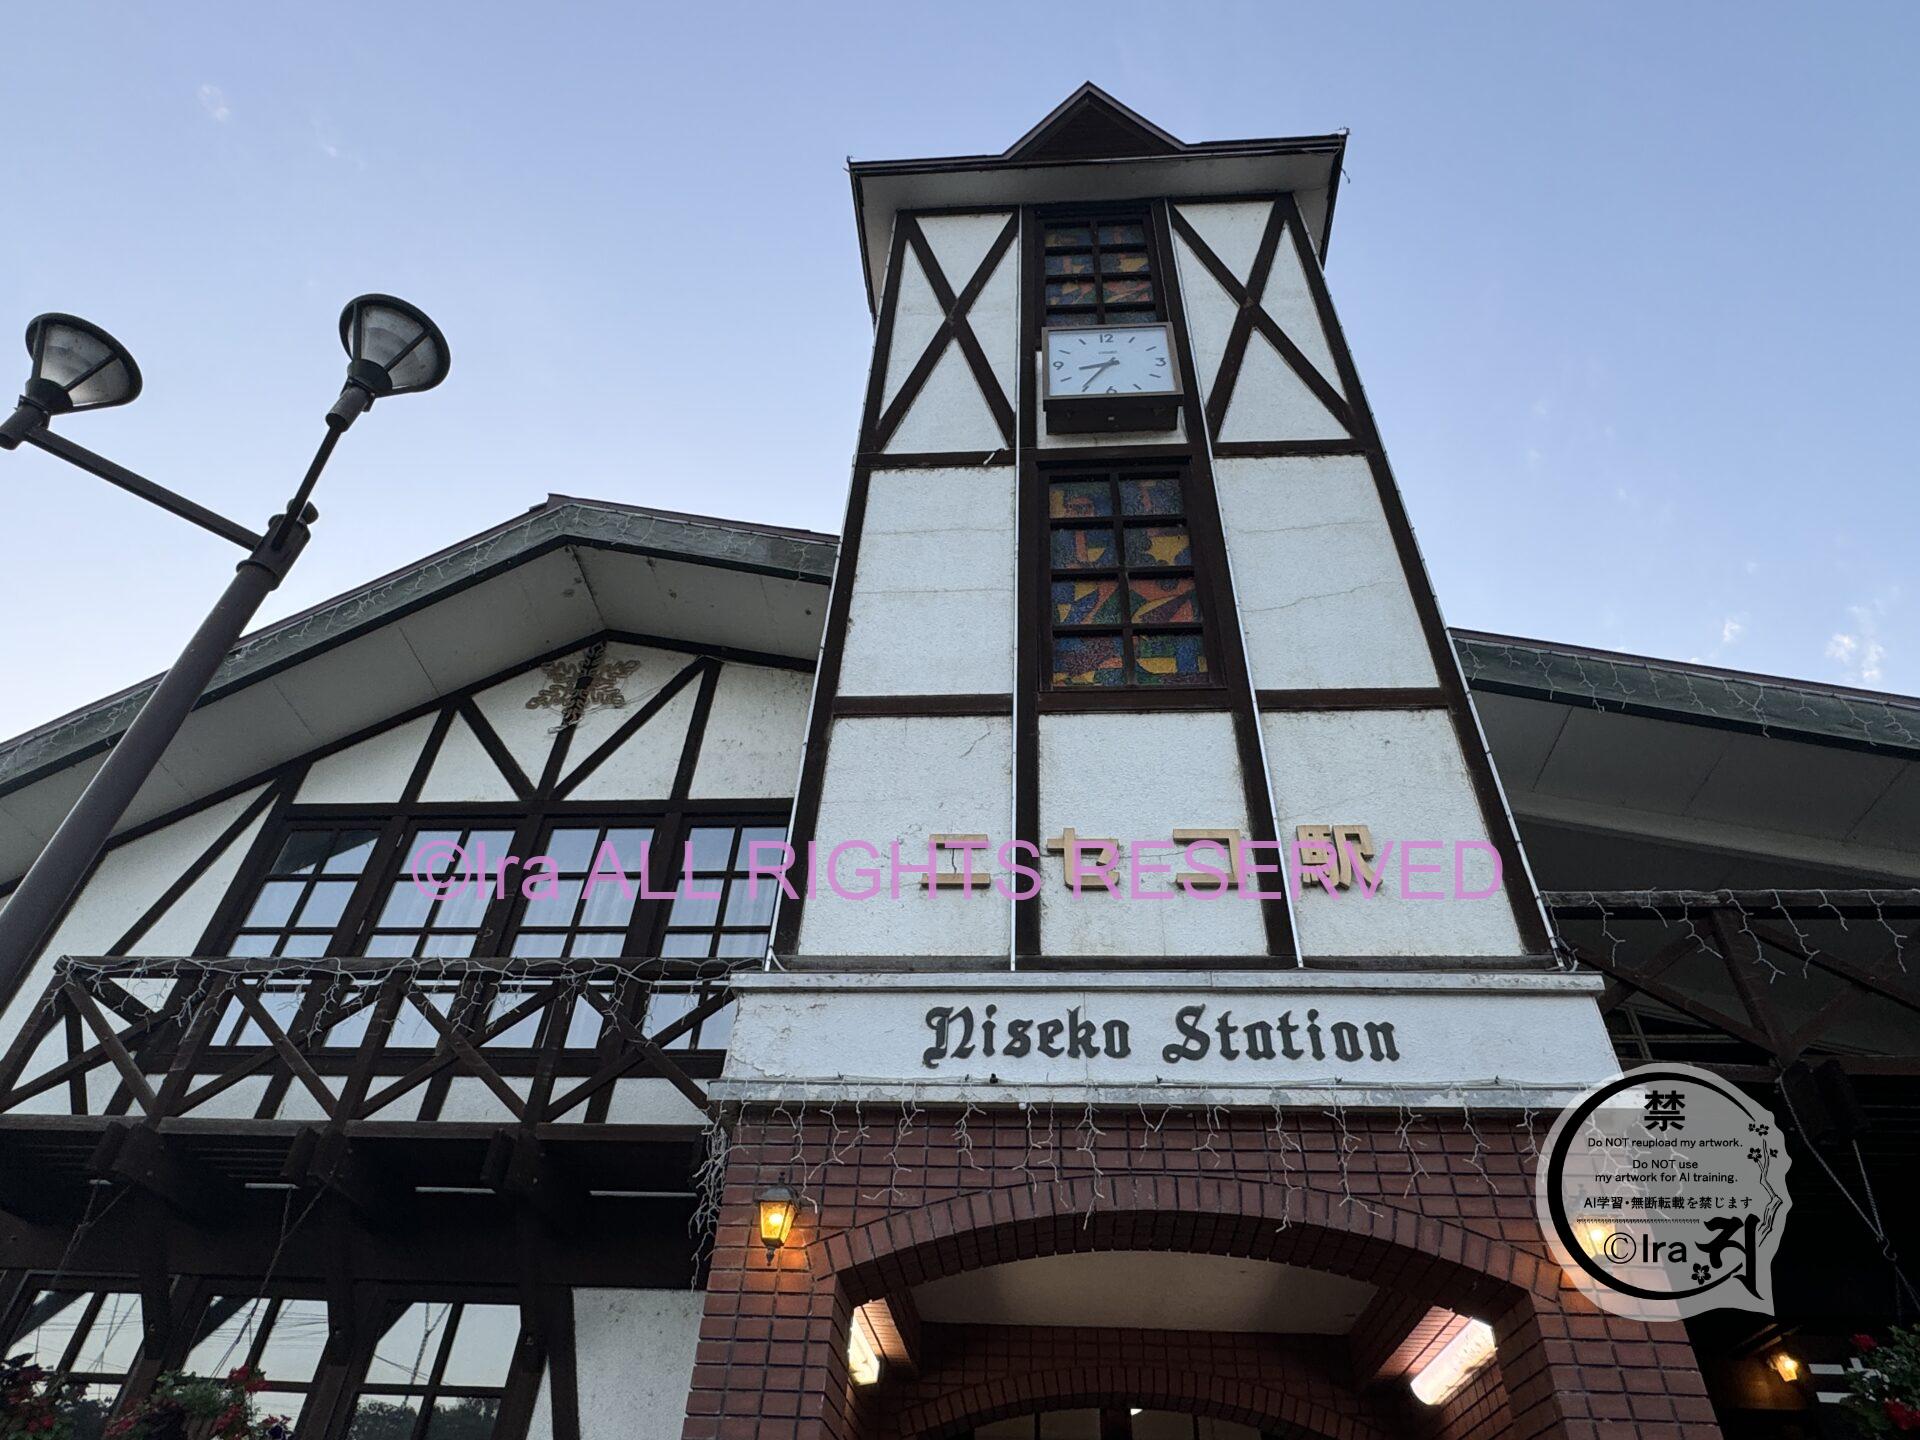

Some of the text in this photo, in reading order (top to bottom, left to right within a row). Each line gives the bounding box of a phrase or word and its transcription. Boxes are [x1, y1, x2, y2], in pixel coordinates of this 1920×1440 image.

[1099, 333, 1114, 344] 12
[1052, 361, 1065, 371] 9
[1155, 357, 1167, 367] 3
[1106, 385, 1118, 394] 6
[921, 824, 1384, 892] ニセコ駅
[922, 1003, 1401, 1070] Niseko Station
